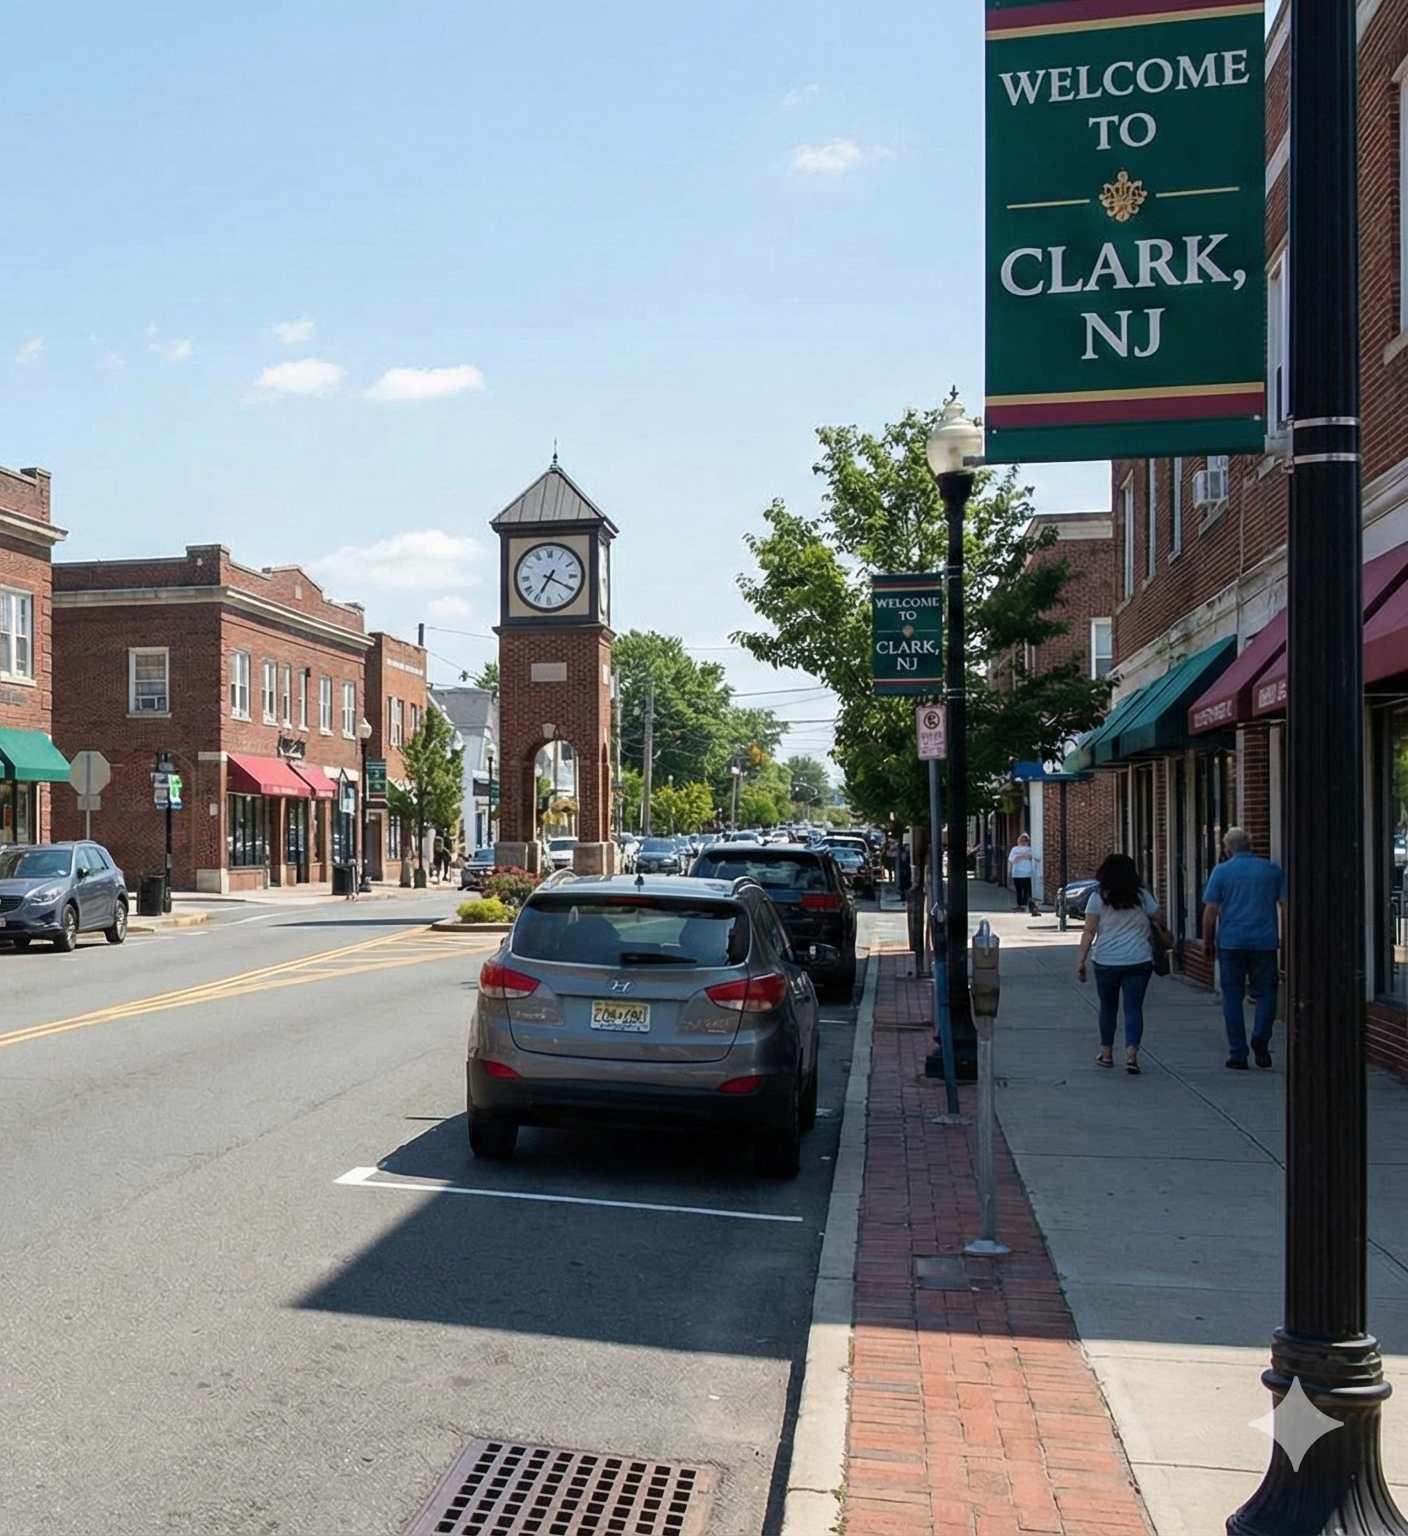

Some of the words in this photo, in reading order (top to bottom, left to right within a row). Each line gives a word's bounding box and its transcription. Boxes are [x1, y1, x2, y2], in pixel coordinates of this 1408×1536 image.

[999, 49, 1250, 107] WELCOME
[1088, 112, 1157, 151] TO
[1000, 233, 1247, 297] CLARK,
[1080, 307, 1166, 360] NJ
[875, 597, 939, 608] WELCOME
[898, 610, 917, 621] TO
[876, 640, 939, 655] CLARK,
[896, 657, 919, 671] NJ
